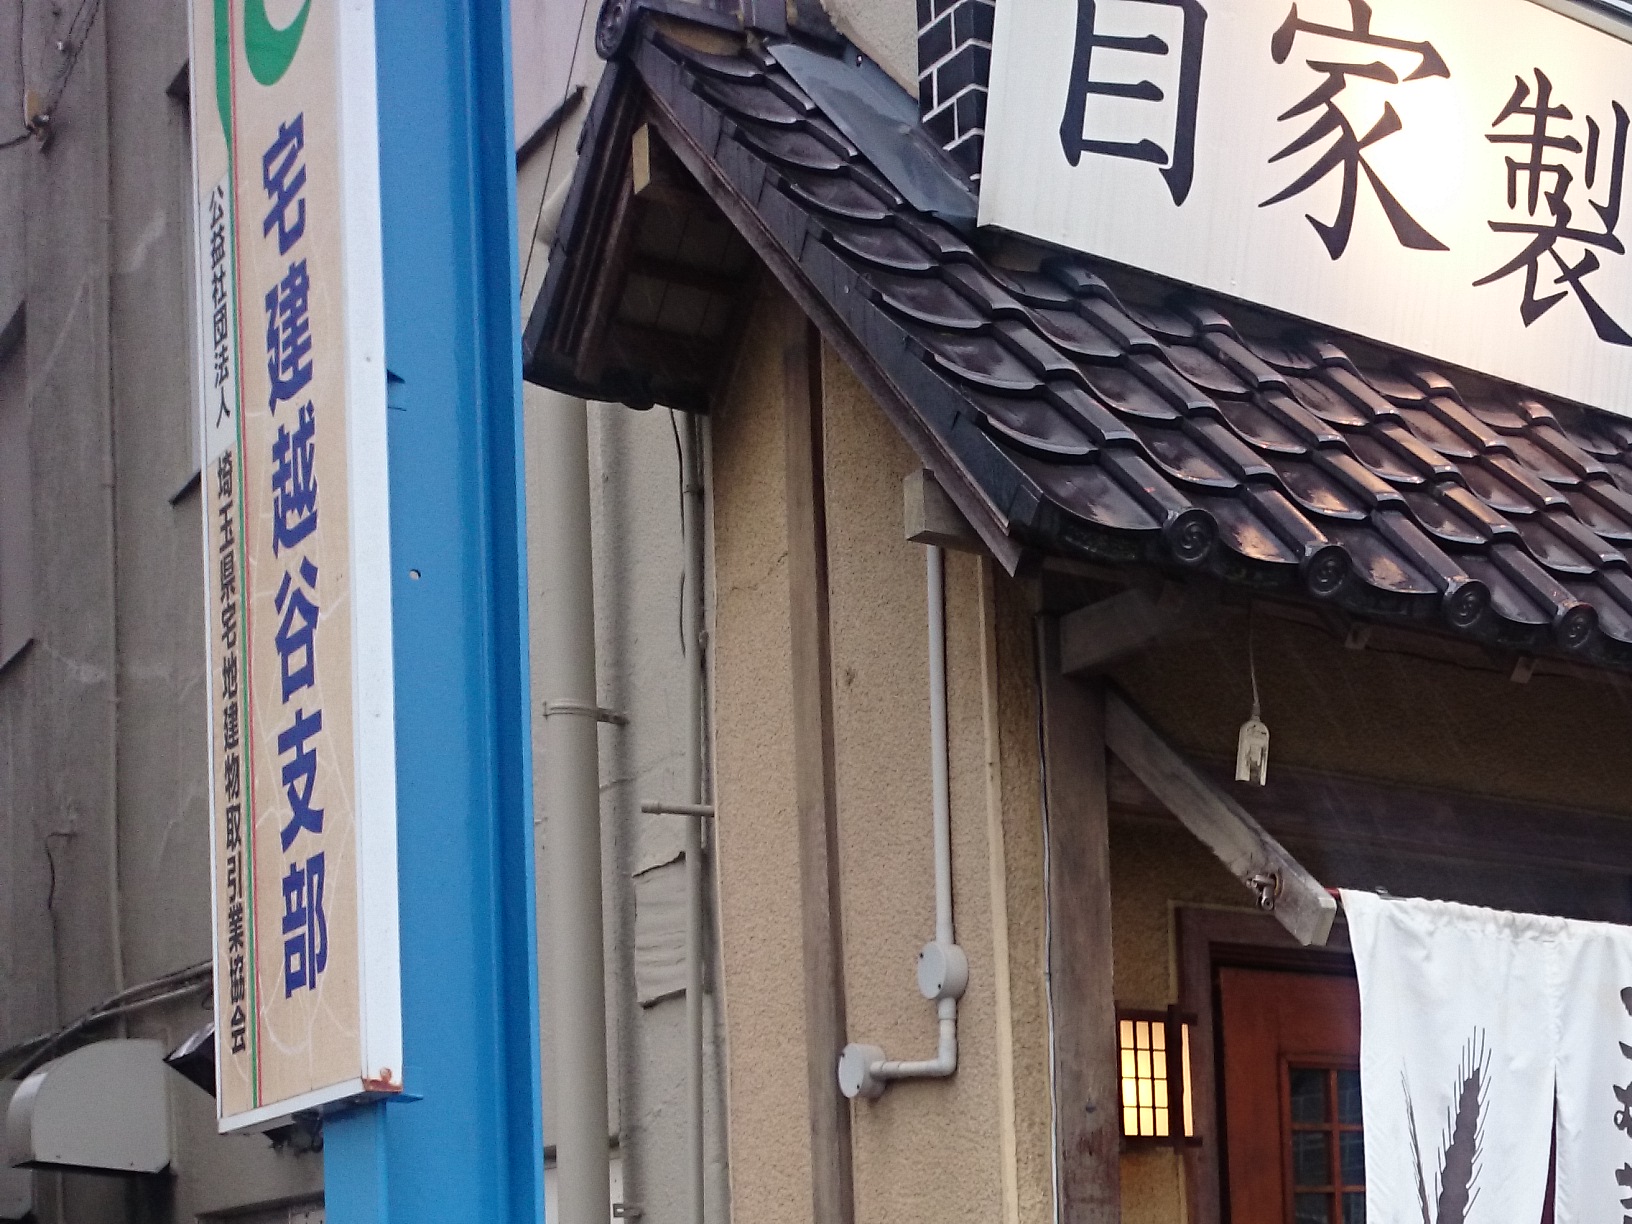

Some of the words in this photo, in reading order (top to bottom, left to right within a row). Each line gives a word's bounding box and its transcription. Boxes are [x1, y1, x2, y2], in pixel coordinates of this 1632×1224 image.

[210, 184, 231, 428] 公益社団法人
[262, 113, 328, 998] 宅建越谷支部
[217, 450, 246, 1056] 埼玉県宅地建物取引業協会
